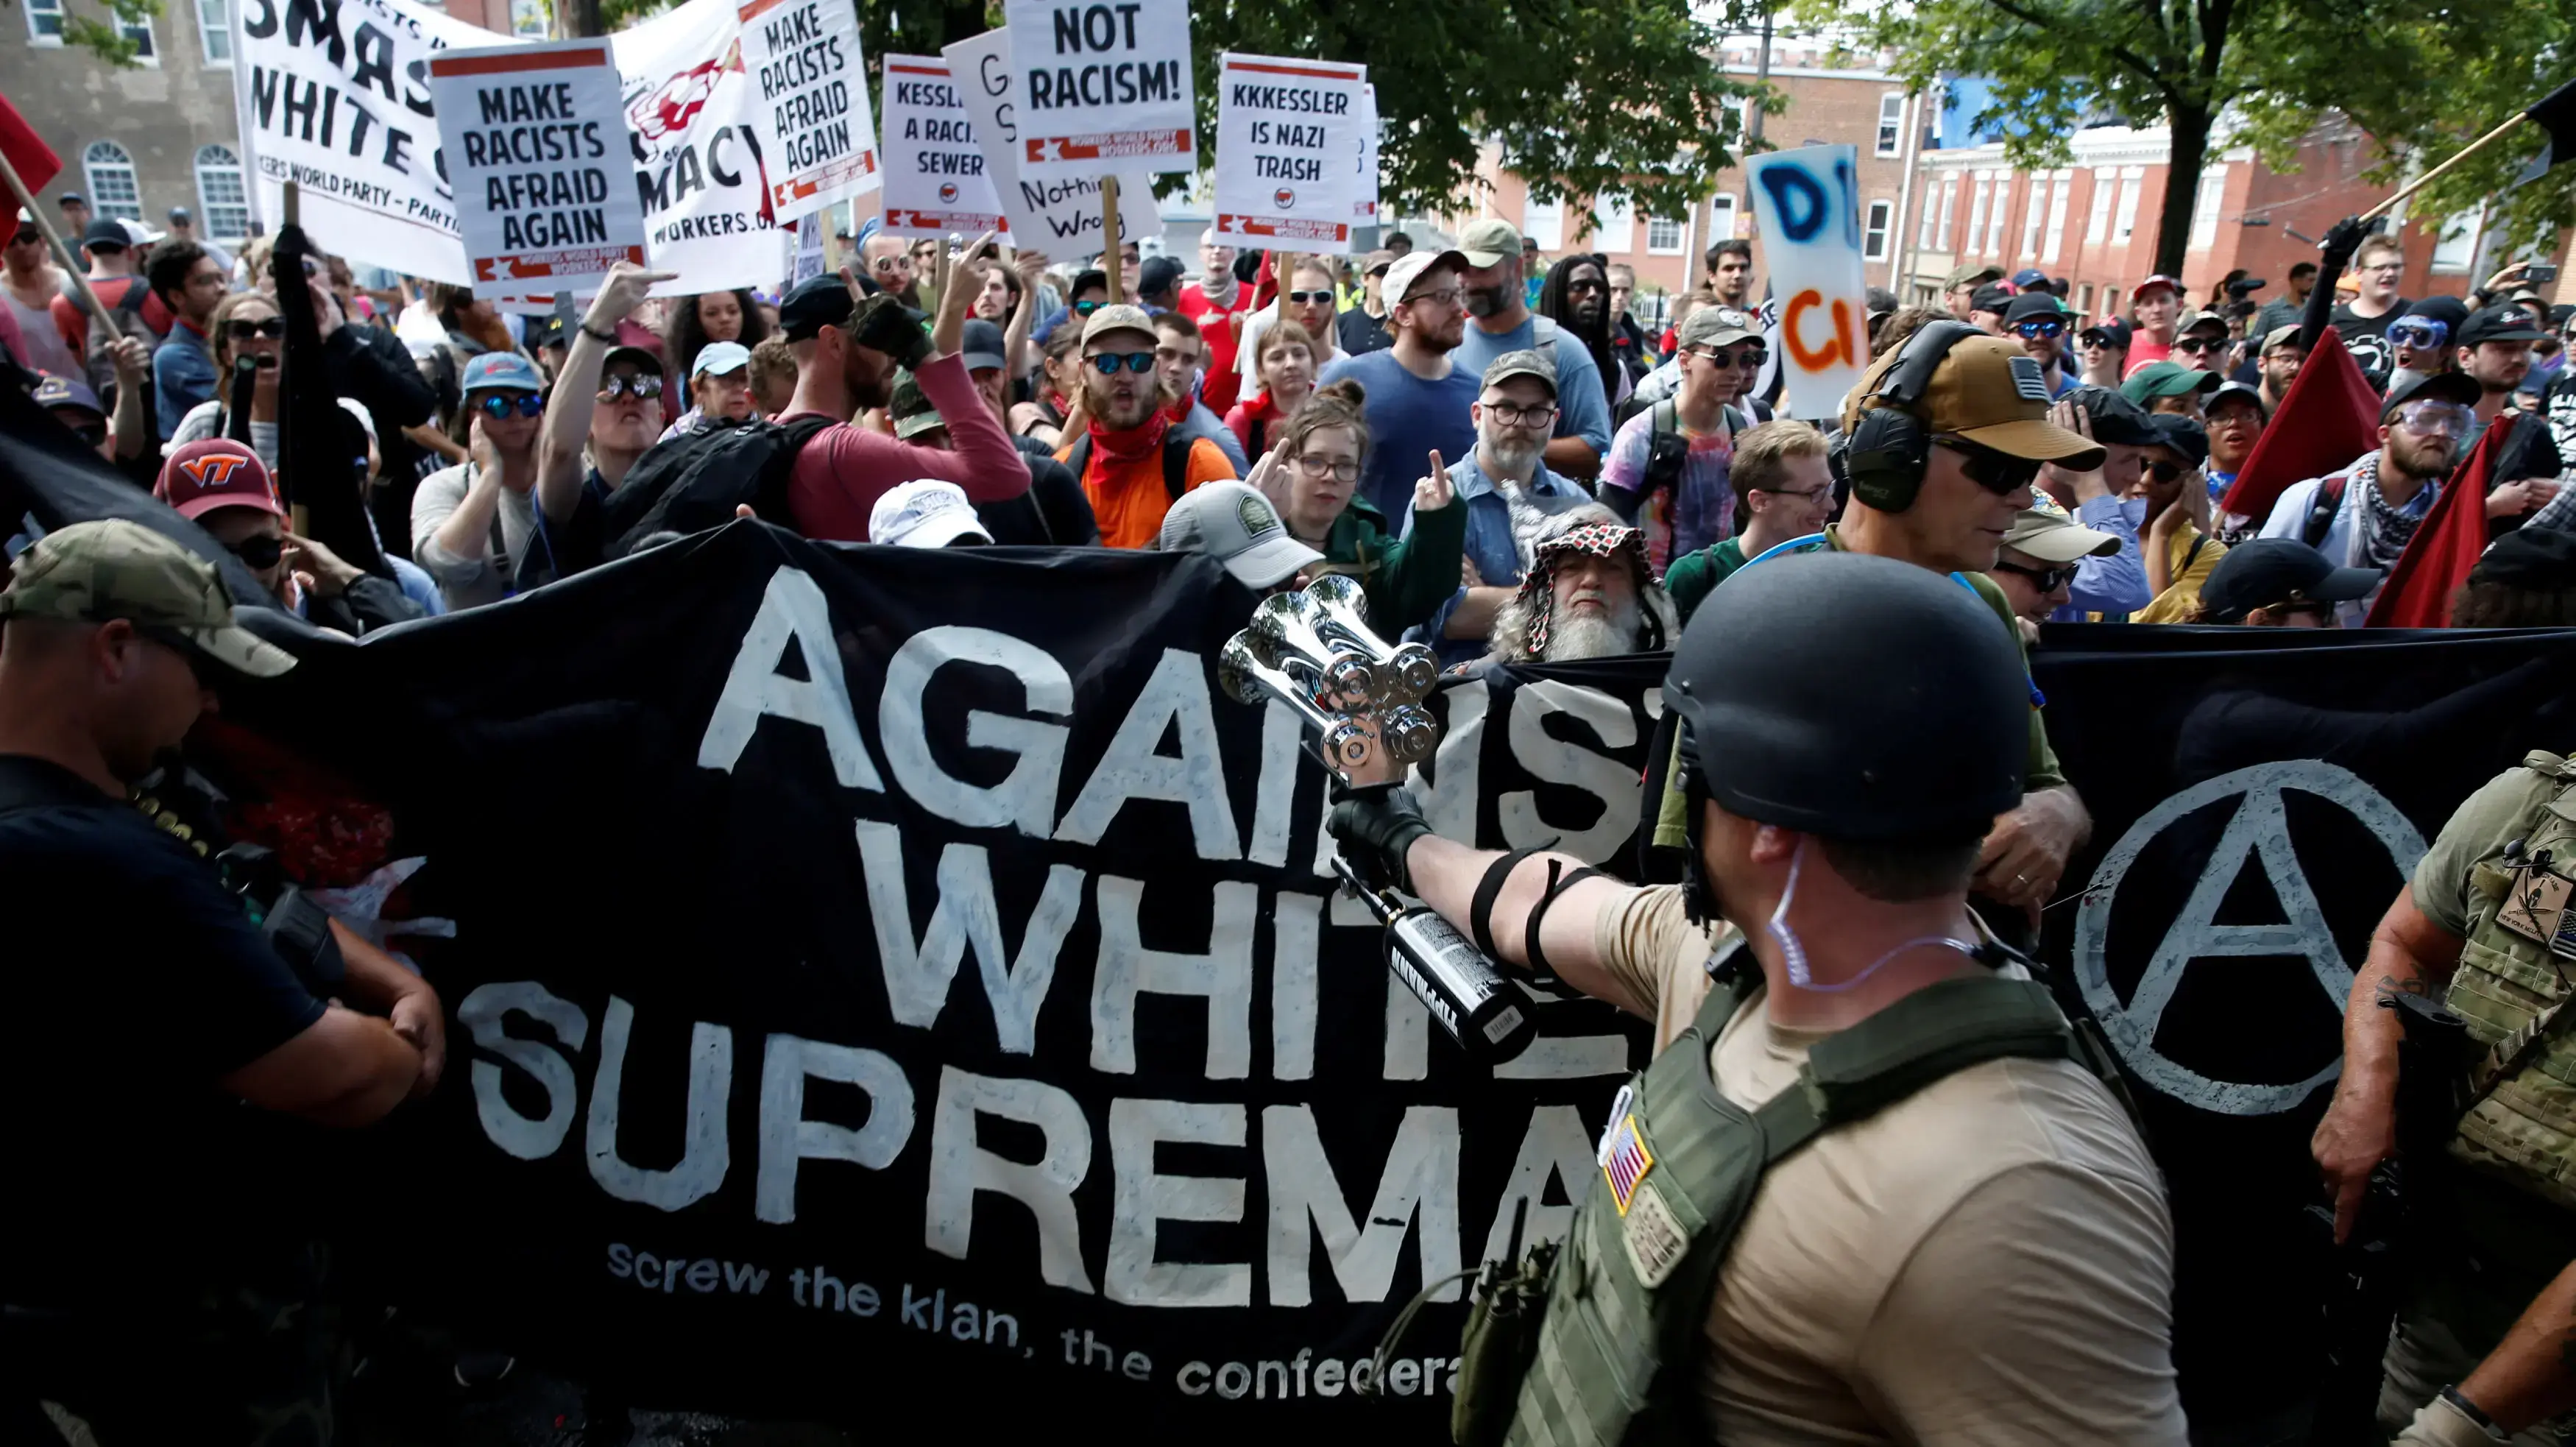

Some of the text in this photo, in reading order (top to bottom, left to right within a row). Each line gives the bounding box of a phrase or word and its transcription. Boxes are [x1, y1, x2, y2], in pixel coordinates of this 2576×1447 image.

[765, 4, 823, 57] MAKE
[1053, 3, 1141, 54] NOT
[760, 35, 845, 101] RACISTS
[1029, 59, 1181, 110] RACISM!
[478, 82, 575, 125] MAKE
[774, 80, 849, 140] AFRAID
[896, 82, 963, 109] KESSL
[1233, 84, 1348, 115] KKKESSLER
[463, 121, 606, 167] RACISTS
[786, 119, 852, 174] AGAIN
[905, 118, 977, 144] A RACI
[1251, 121, 1325, 149] IS NAZI
[917, 151, 984, 176] SEWER
[1254, 155, 1320, 181] TRASH
[290, 162, 339, 192] WORLD
[342, 176, 391, 207] PARTY
[408, 197, 461, 234] PARTI
[486, 168, 608, 211] AFRAID
[1019, 174, 1120, 213] Nothi
[503, 208, 607, 250] AGAIN
[654, 210, 779, 244] WORKERS.O
[1047, 210, 1125, 241] Wrog
[180, 453, 249, 489] VT
[697, 565, 1663, 877] AGAINS
[2499, 913, 2511, 922] NEW
[2511, 918, 2524, 930] YORK
[1392, 946, 1458, 1039] TIPPMANN
[457, 980, 1603, 1307] SUPREMA
[607, 1243, 769, 1295] screw
[790, 1266, 880, 1317] the
[902, 1284, 1034, 1359] klan,
[1061, 1329, 1152, 1381] the
